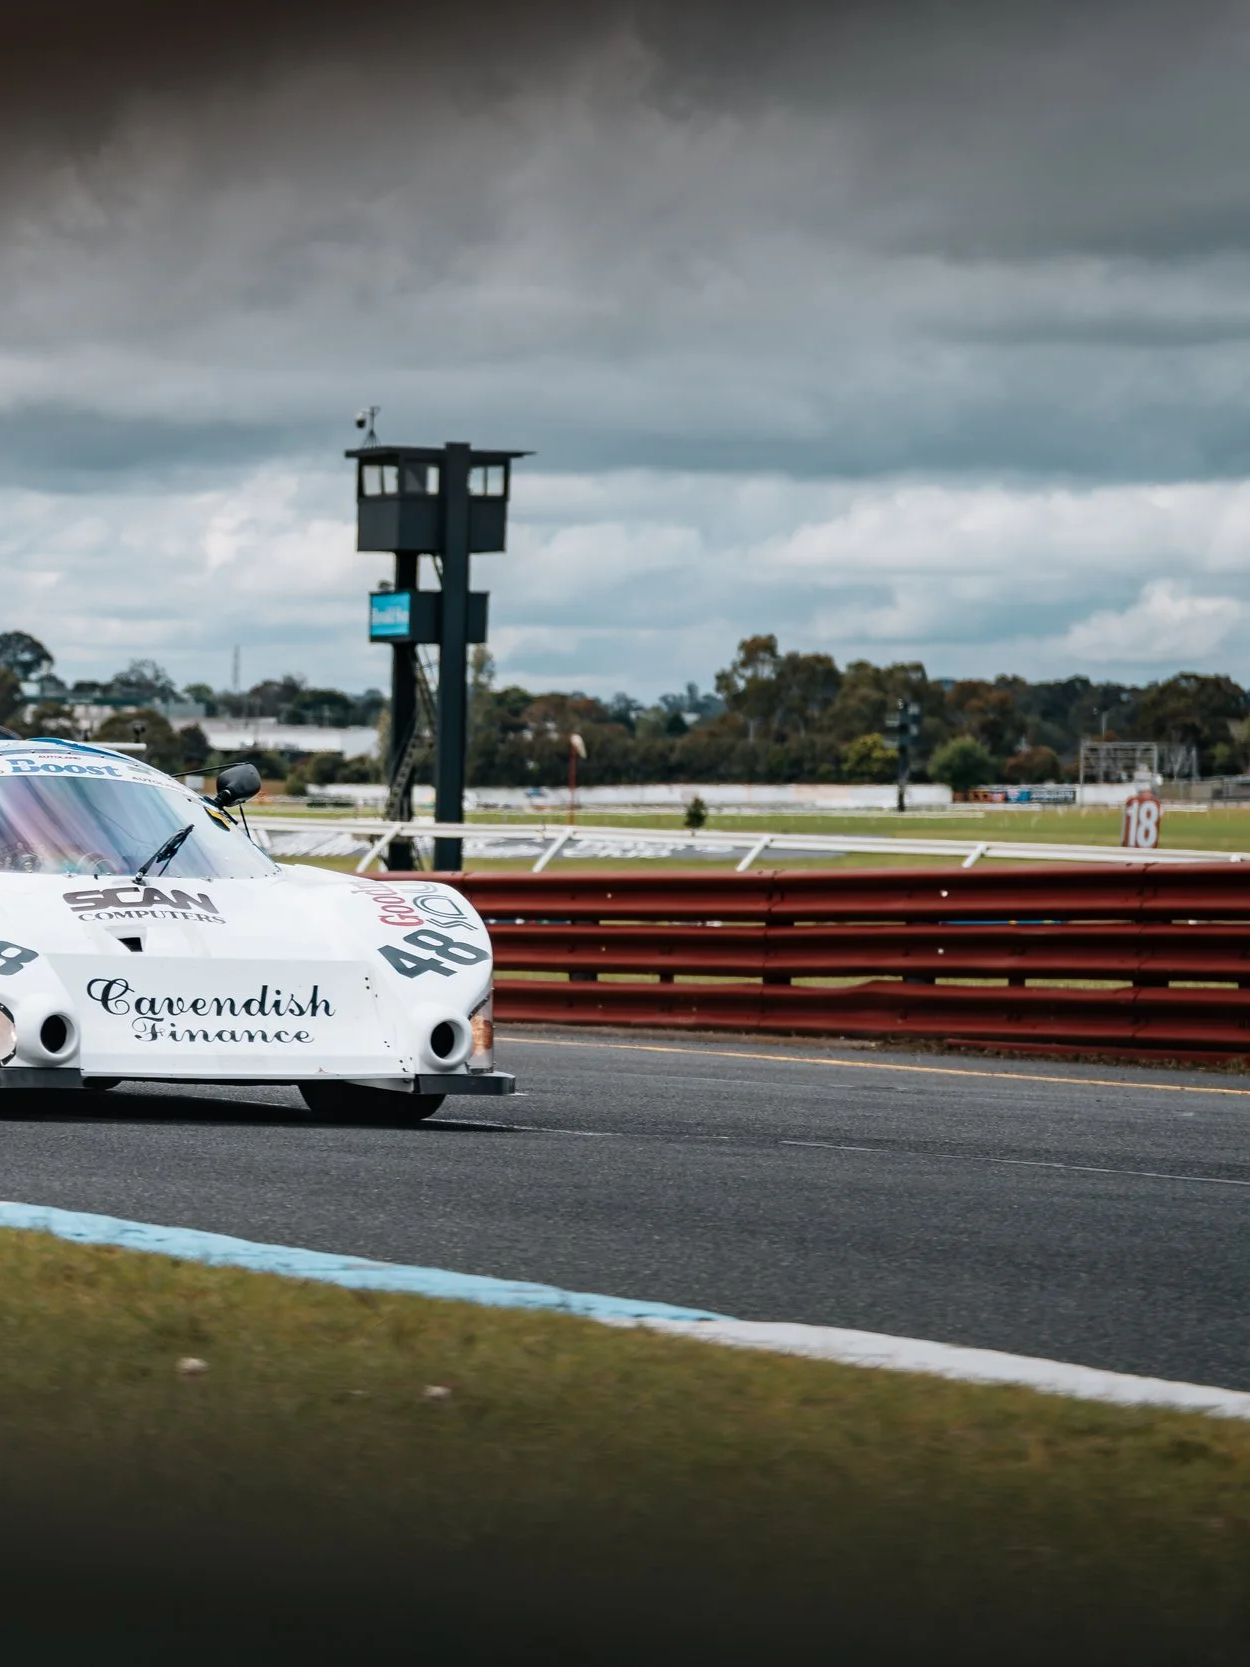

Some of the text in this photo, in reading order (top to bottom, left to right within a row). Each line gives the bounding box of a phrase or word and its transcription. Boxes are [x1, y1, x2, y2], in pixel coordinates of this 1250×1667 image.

[1125, 799, 1159, 848] 18
[62, 886, 220, 914] SCAN
[78, 910, 227, 925] COMPUTERS
[376, 928, 490, 979] 48
[86, 978, 337, 1017] Cavendish
[131, 1016, 315, 1043] Finance
